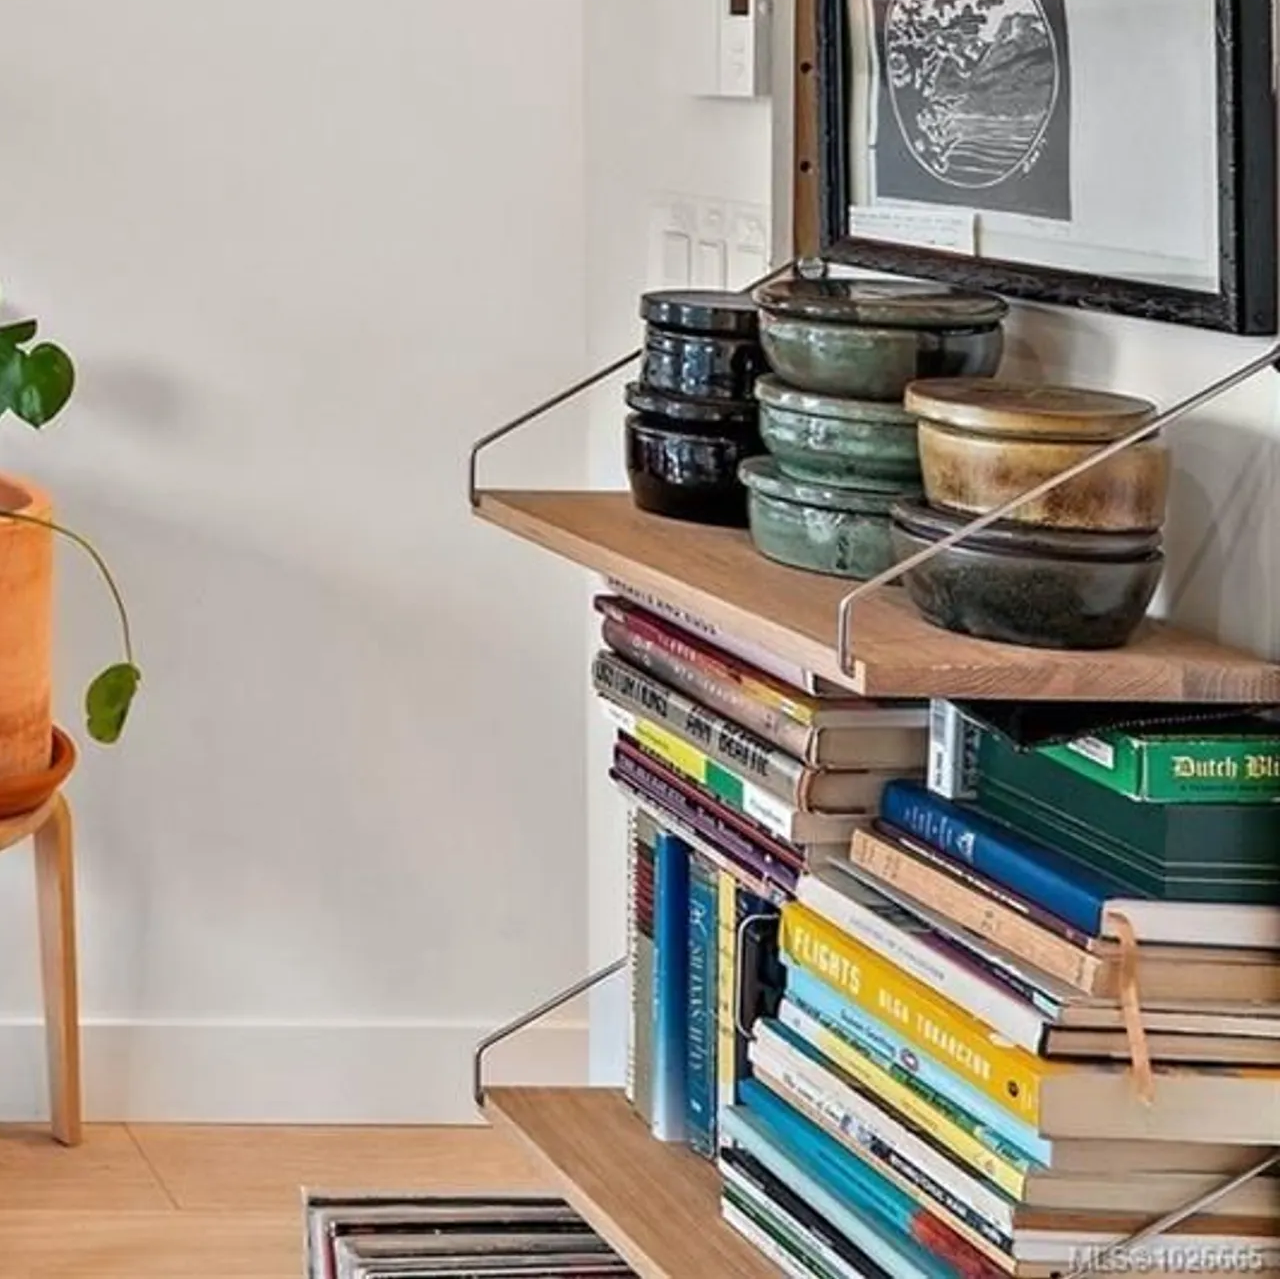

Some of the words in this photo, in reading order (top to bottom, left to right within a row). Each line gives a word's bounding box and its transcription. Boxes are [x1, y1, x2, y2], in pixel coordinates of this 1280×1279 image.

[1172, 755, 1238, 779] Dutch
[1244, 755, 1280, 779] Bli
[794, 926, 861, 996] FLIGHTS
[878, 988, 910, 1024] OLGA
[916, 1011, 992, 1080] TOKARCZUK
